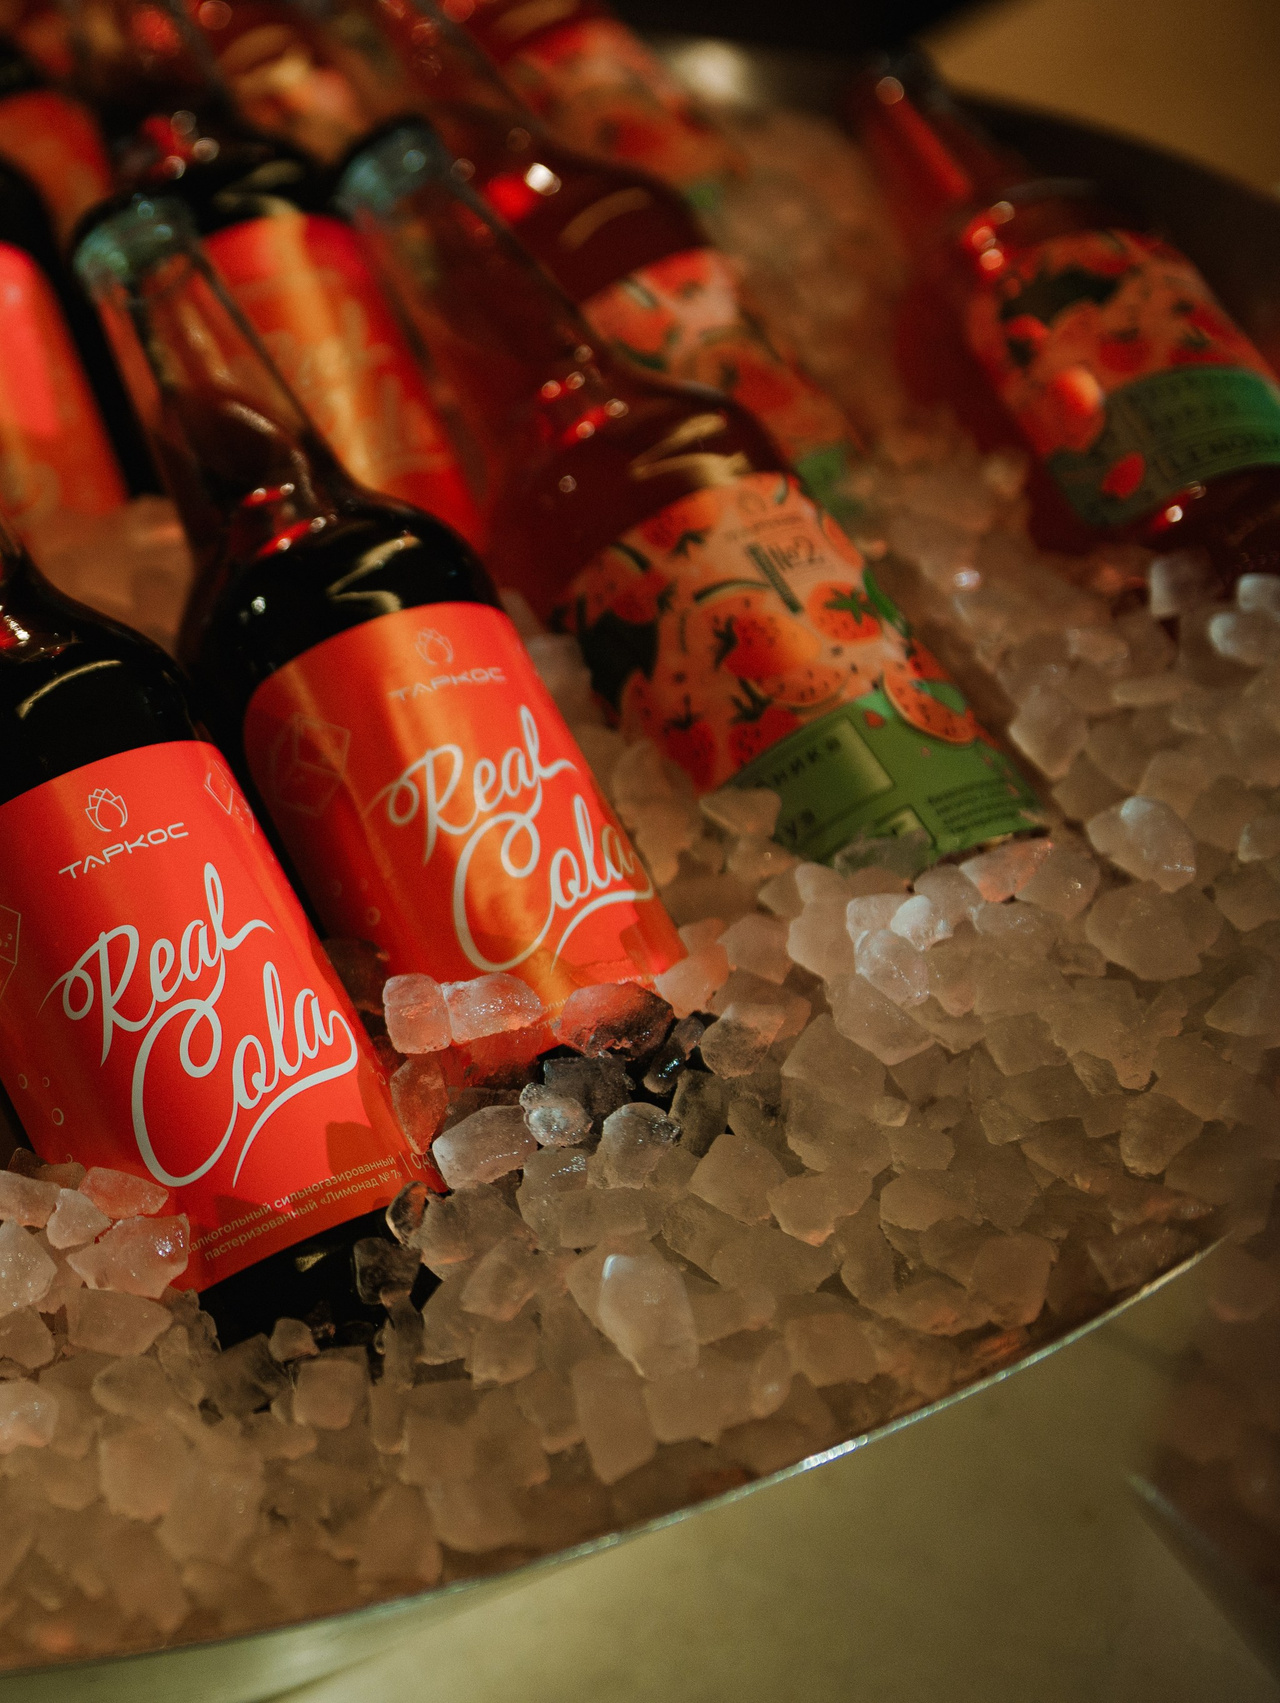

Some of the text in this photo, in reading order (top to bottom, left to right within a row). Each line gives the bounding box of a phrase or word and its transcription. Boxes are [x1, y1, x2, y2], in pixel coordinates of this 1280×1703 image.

[388, 665, 507, 702] ТАРКОС
[362, 703, 578, 865] Real
[58, 821, 189, 879] ТАРКОС
[452, 794, 656, 973] Cola
[37, 861, 276, 1067] Real
[130, 960, 359, 1188] Cola
[188, 1155, 396, 1254] алкогольный сильногазированный
[204, 1201, 318, 1262] пастеризованный
